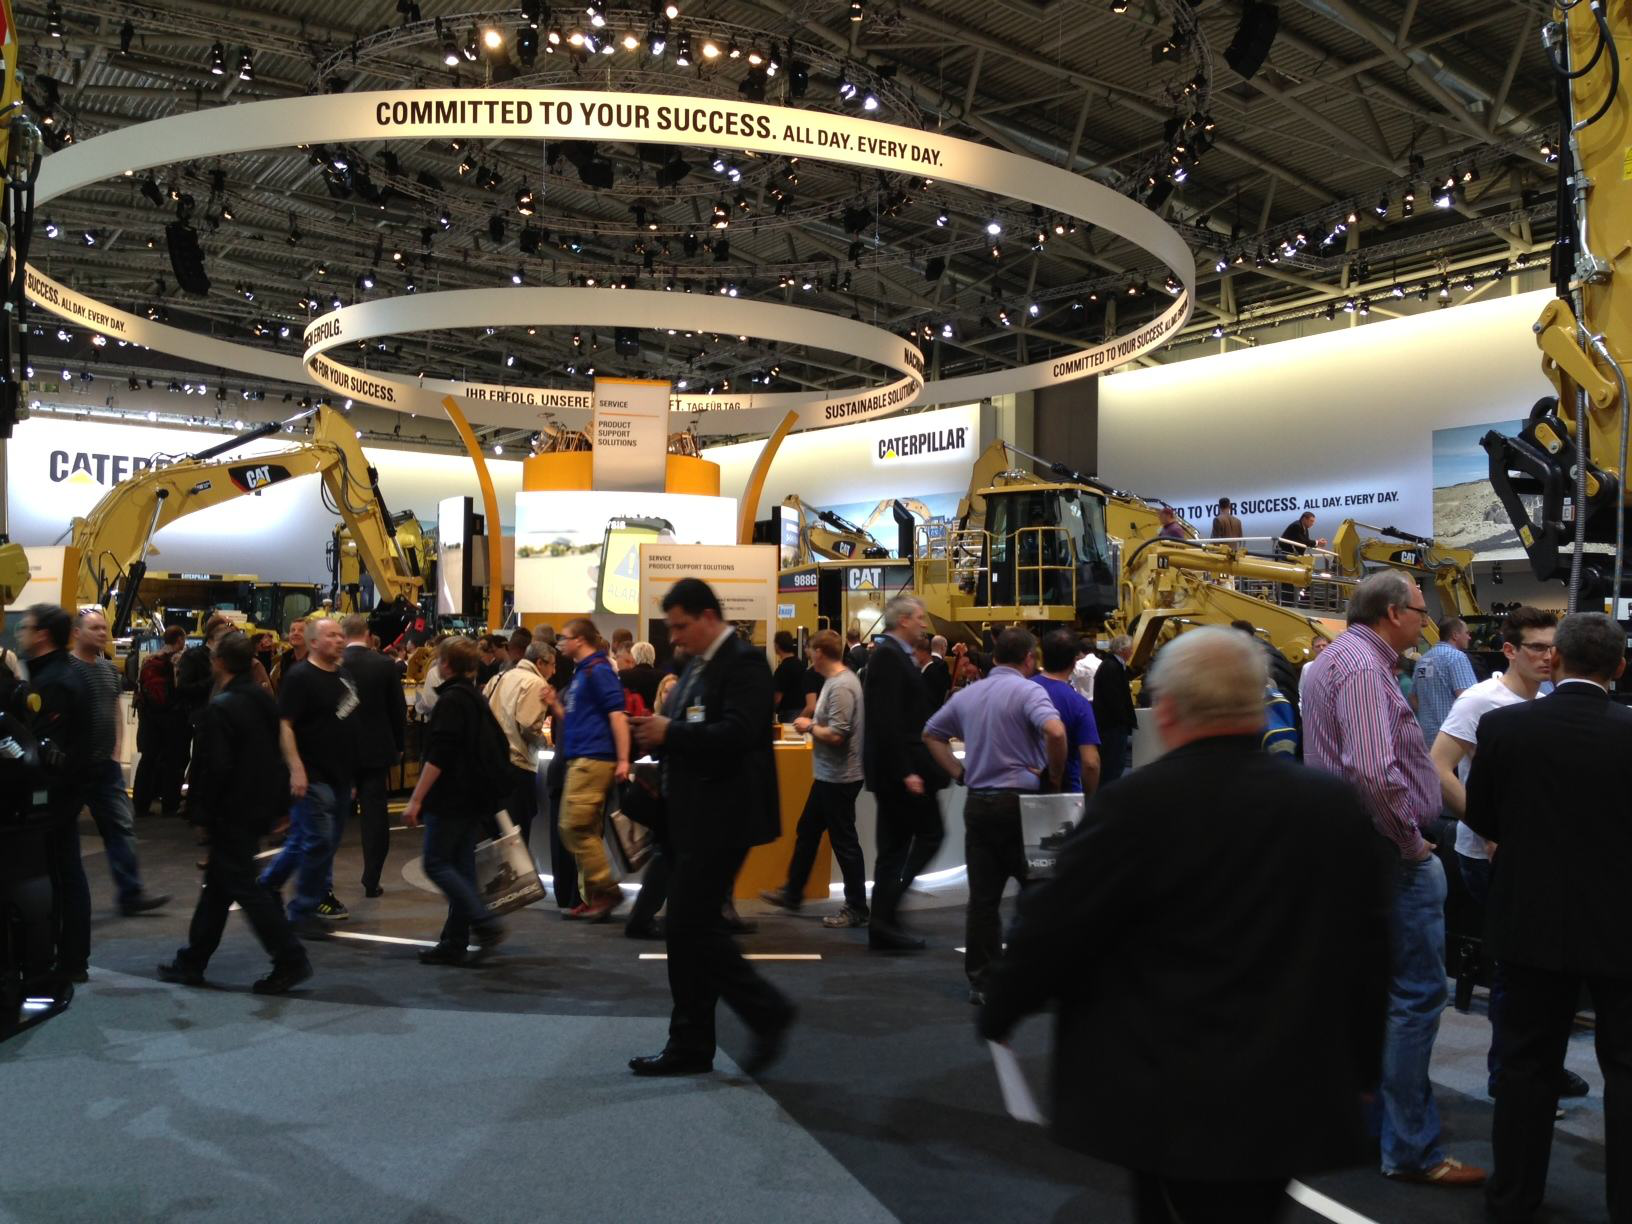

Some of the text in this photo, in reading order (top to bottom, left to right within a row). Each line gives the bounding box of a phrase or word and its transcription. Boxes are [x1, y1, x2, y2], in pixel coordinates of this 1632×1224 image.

[376, 100, 943, 167] COMMITTED TO YOUR SUCCESS. ALL DAY. EVERY DAY.
[61, 297, 74, 312] ALL
[88, 309, 110, 328] EVERY
[313, 318, 342, 345] ERFOLG.
[1053, 353, 1105, 377] COMMITTED
[1106, 346, 1117, 362] TO
[1117, 338, 1136, 358] YOUR
[318, 360, 329, 380] FOR
[329, 367, 349, 389] YOUR
[350, 376, 396, 402] SUCCESS.
[466, 387, 486, 401] IHR
[490, 390, 538, 406] ERFOLG.
[541, 394, 590, 408] UNSERE
[599, 399, 628, 409] SERVICE
[825, 393, 887, 419] SUSTAINABLE
[598, 420, 631, 430] PRODUCT
[598, 429, 631, 438] SUPPORT
[598, 438, 637, 448] SOLUTIONS
[246, 465, 271, 489] CAT
[1188, 505, 1203, 520] TO
[1205, 502, 1238, 518] YOR
[1240, 496, 1300, 516] SUCCESS.
[1304, 499, 1320, 509] ALL
[1322, 496, 1343, 508] DAY.
[1345, 493, 1376, 506] EVERY
[1377, 491, 1399, 503] DAY.
[839, 541, 850, 557] CAT
[1401, 551, 1416, 565] CAT
[794, 574, 817, 587] 988G
[849, 568, 882, 590] CAT
